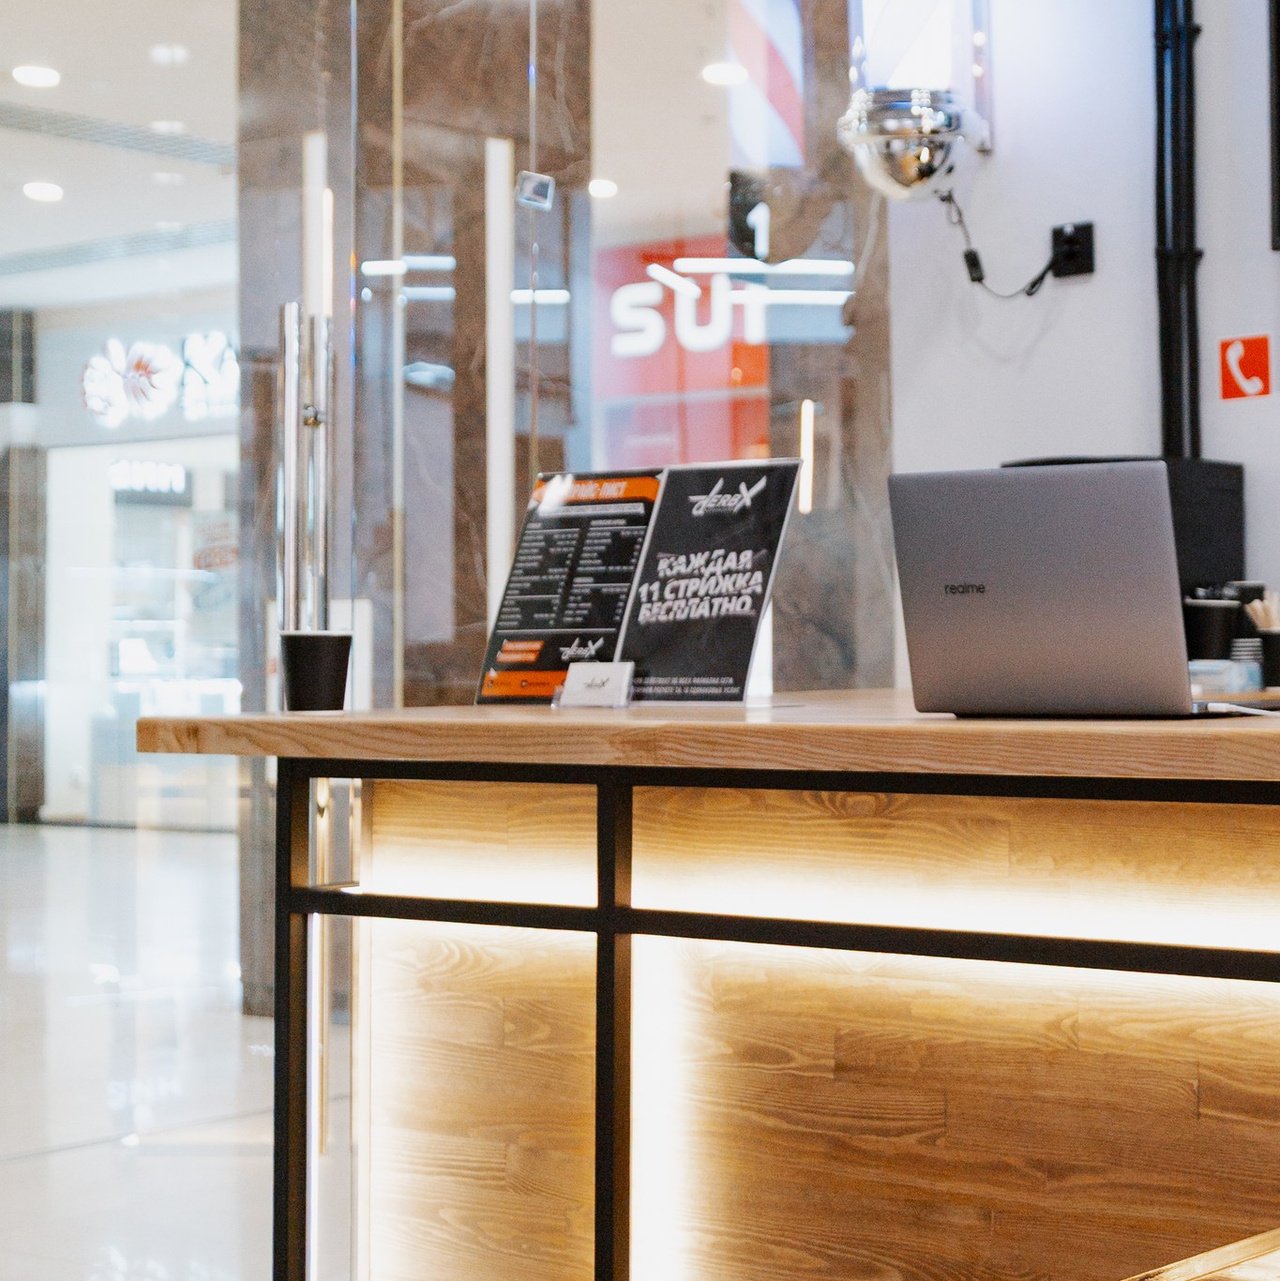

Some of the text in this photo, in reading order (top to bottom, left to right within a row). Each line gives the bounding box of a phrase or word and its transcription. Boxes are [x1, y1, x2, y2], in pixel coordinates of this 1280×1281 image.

[658, 549, 753, 578] КАЖДАЯ
[638, 571, 763, 603] 11 СТРИЖКА
[945, 582, 986, 595] realme
[638, 596, 753, 625] БЕСПЛАТНО
